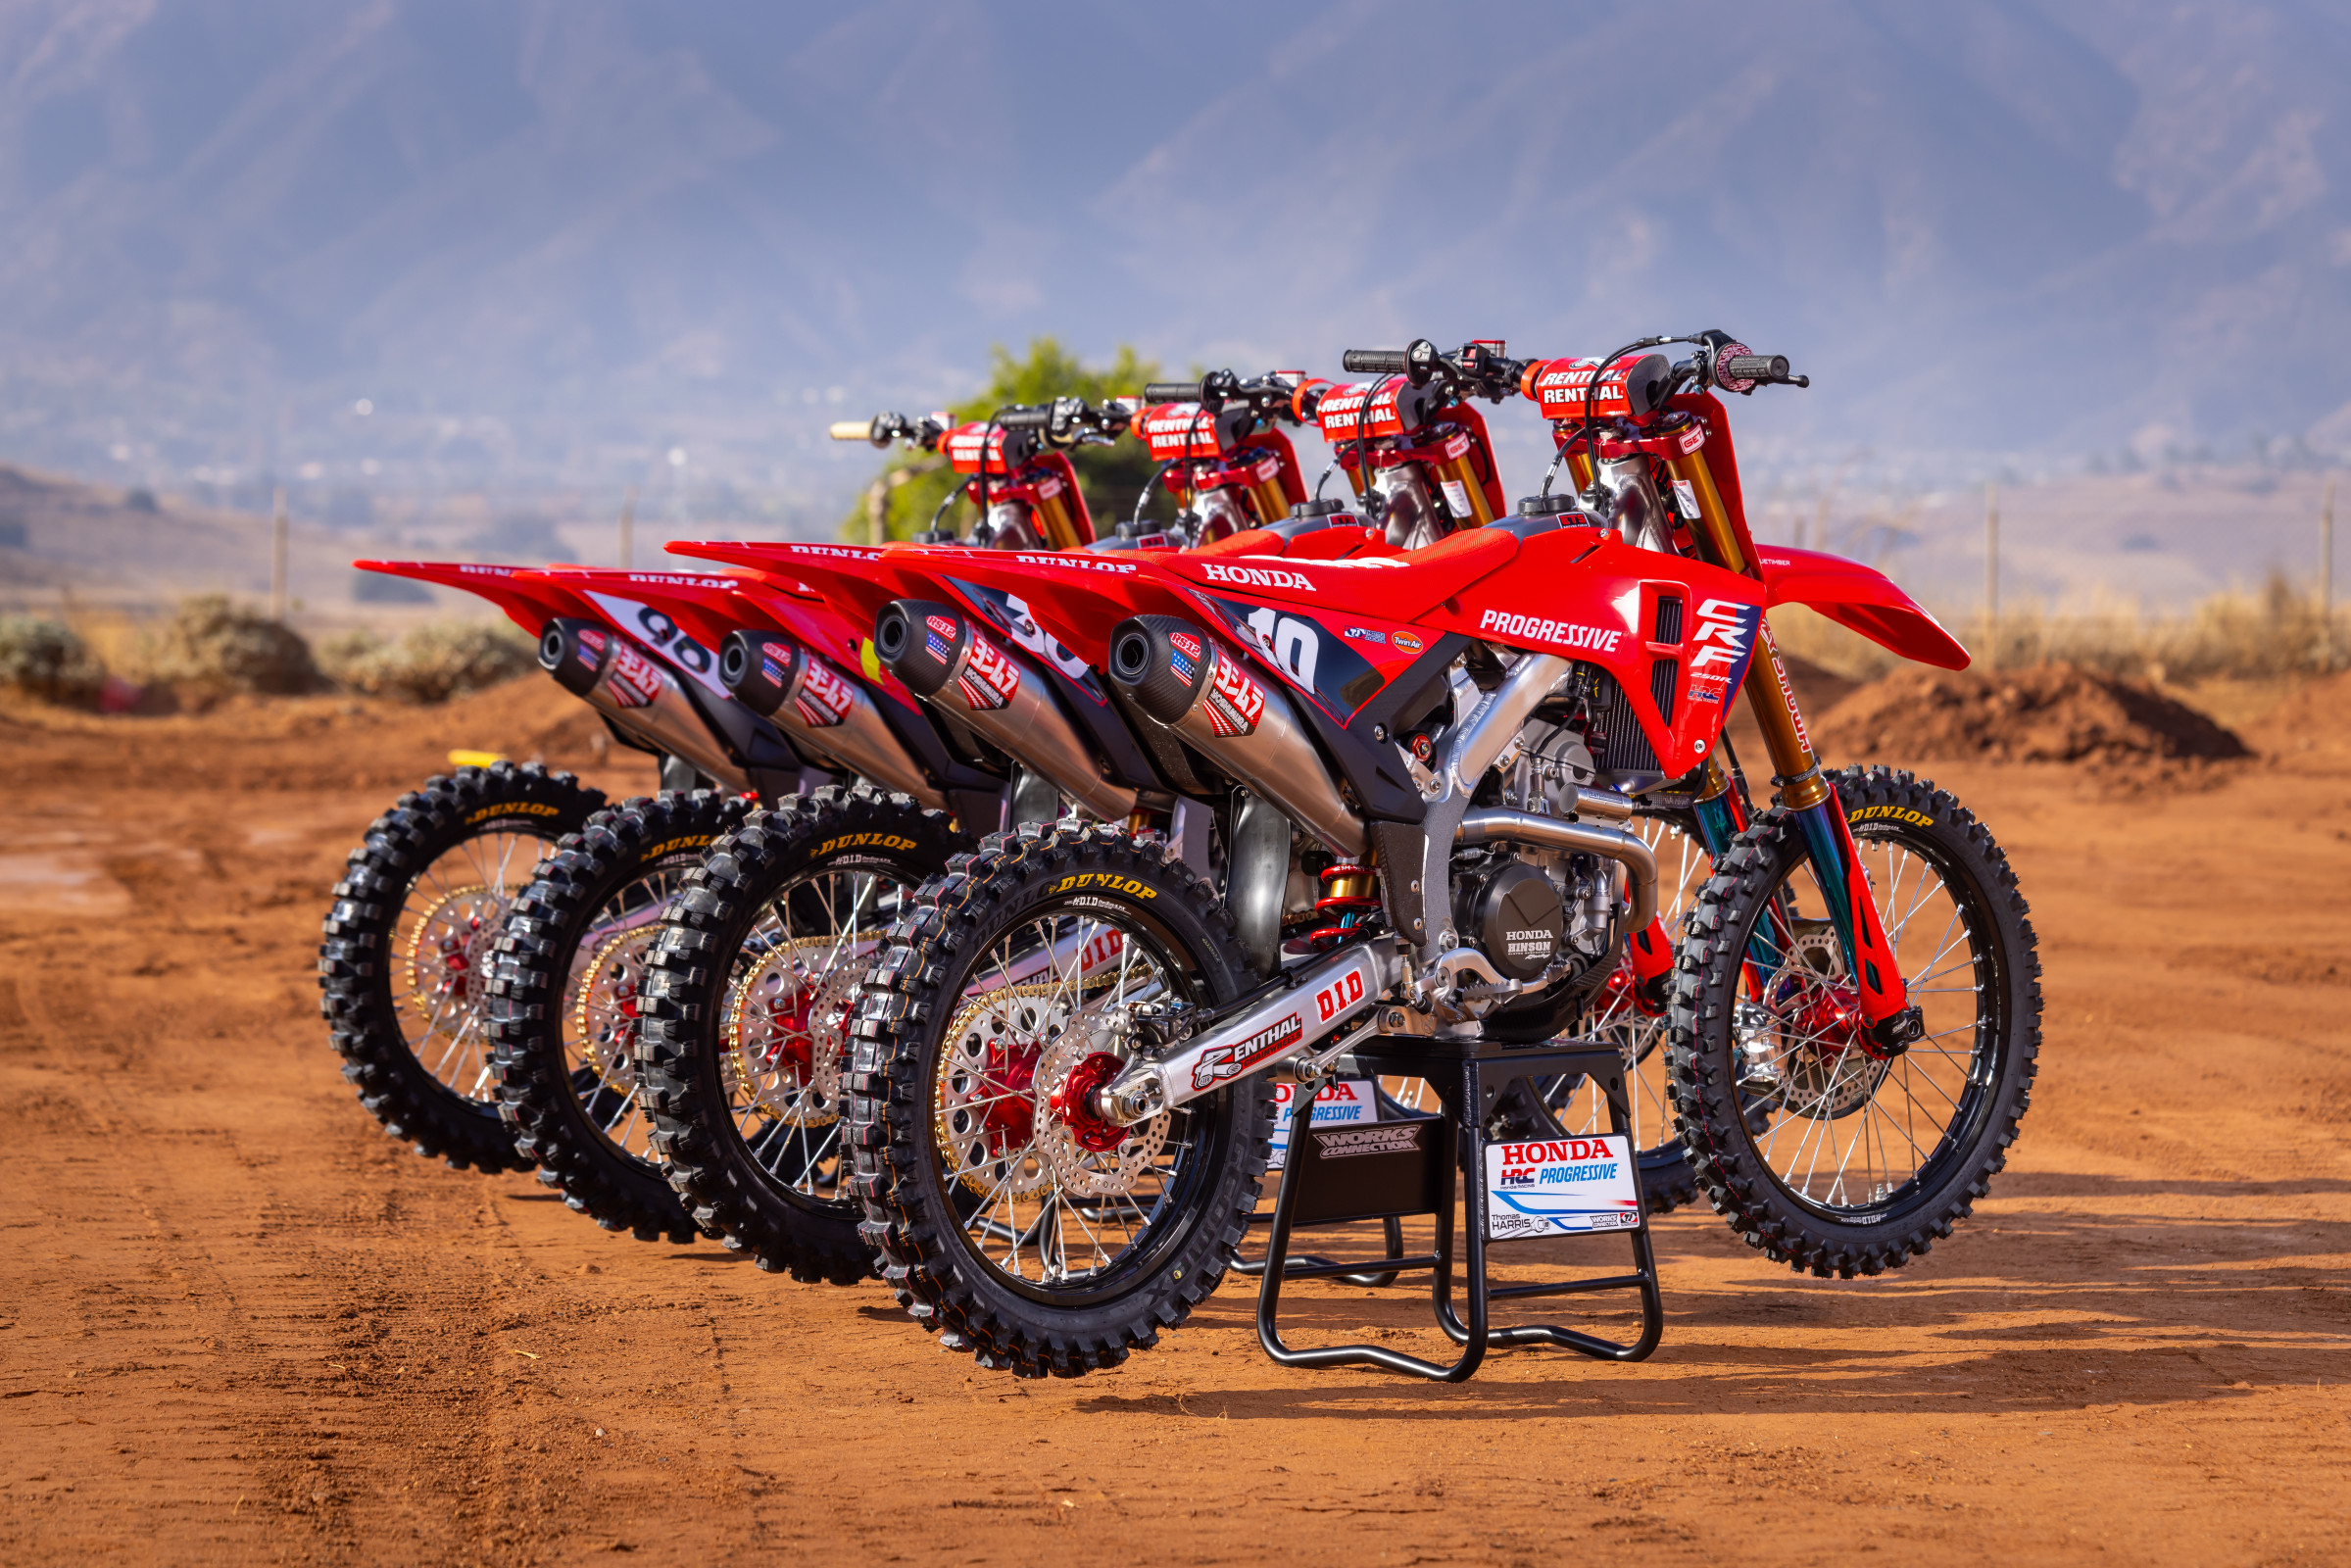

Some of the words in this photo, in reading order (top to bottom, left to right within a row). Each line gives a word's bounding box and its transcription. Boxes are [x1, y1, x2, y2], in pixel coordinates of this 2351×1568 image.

[1684, 431, 1703, 448] GET
[1560, 514, 1587, 525] ETS
[1016, 555, 1137, 574] DUNLOP
[1200, 563, 1317, 592] HONDA
[1479, 609, 1622, 653] PROGRESSIVE
[1690, 599, 1751, 667] CRF
[1248, 607, 1319, 695] 10
[1394, 636, 1410, 647] Twin
[1410, 640, 1422, 650] Air
[1209, 688, 1249, 733] YOSHIMURA
[473, 802, 560, 822] DUNLOP
[1847, 806, 1935, 827] DUNLOP
[818, 832, 917, 856] DUNLOP
[1056, 873, 1157, 900] DUNLOP
[1505, 930, 1554, 941] HONDA
[1507, 941, 1551, 953] HINSON
[1316, 970, 1364, 1023] D.I.D
[1244, 1031, 1301, 1067] CHAINWHEELS
[1282, 1105, 1362, 1122] PGRESSIVE
[1320, 1126, 1420, 1147] WORKS
[1321, 1139, 1415, 1156] CONNECTION
[1501, 1139, 1614, 1166] HONDA
[1500, 1167, 1536, 1186] HRC
[1539, 1163, 1619, 1185] PROGRESSIVE
[1493, 1218, 1531, 1231] HARRIS
[1591, 1214, 1617, 1223] WORKS
